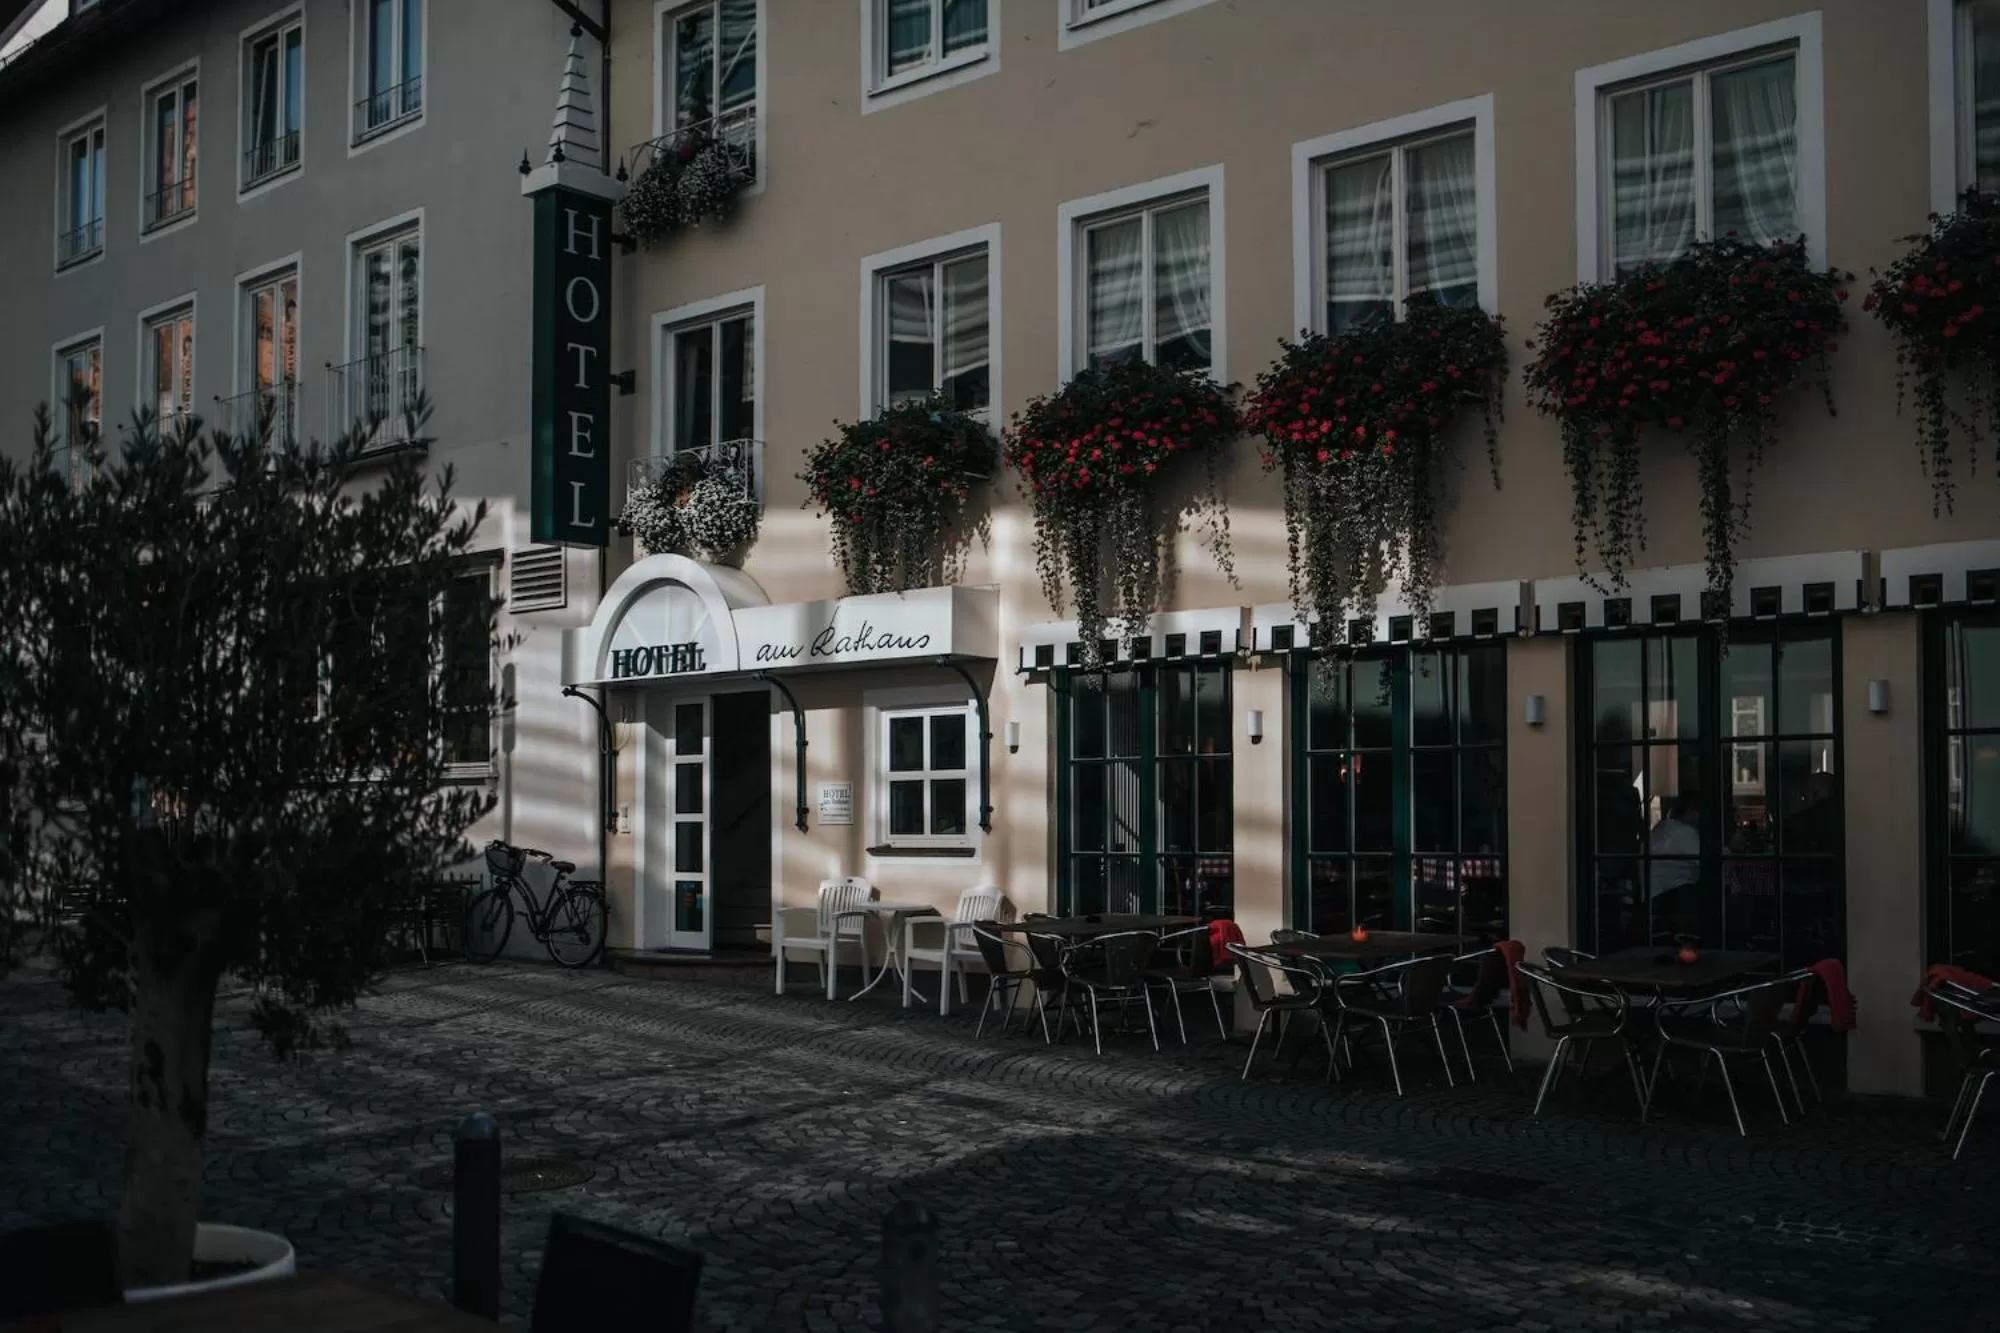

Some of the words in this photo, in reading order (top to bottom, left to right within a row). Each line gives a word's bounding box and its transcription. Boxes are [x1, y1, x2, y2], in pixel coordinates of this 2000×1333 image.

[564, 208, 601, 528] HOTEL
[611, 642, 707, 679] HOTEL
[756, 643, 803, 662] am
[810, 605, 931, 657] Rathaus
[823, 789, 851, 799] HOTEL
